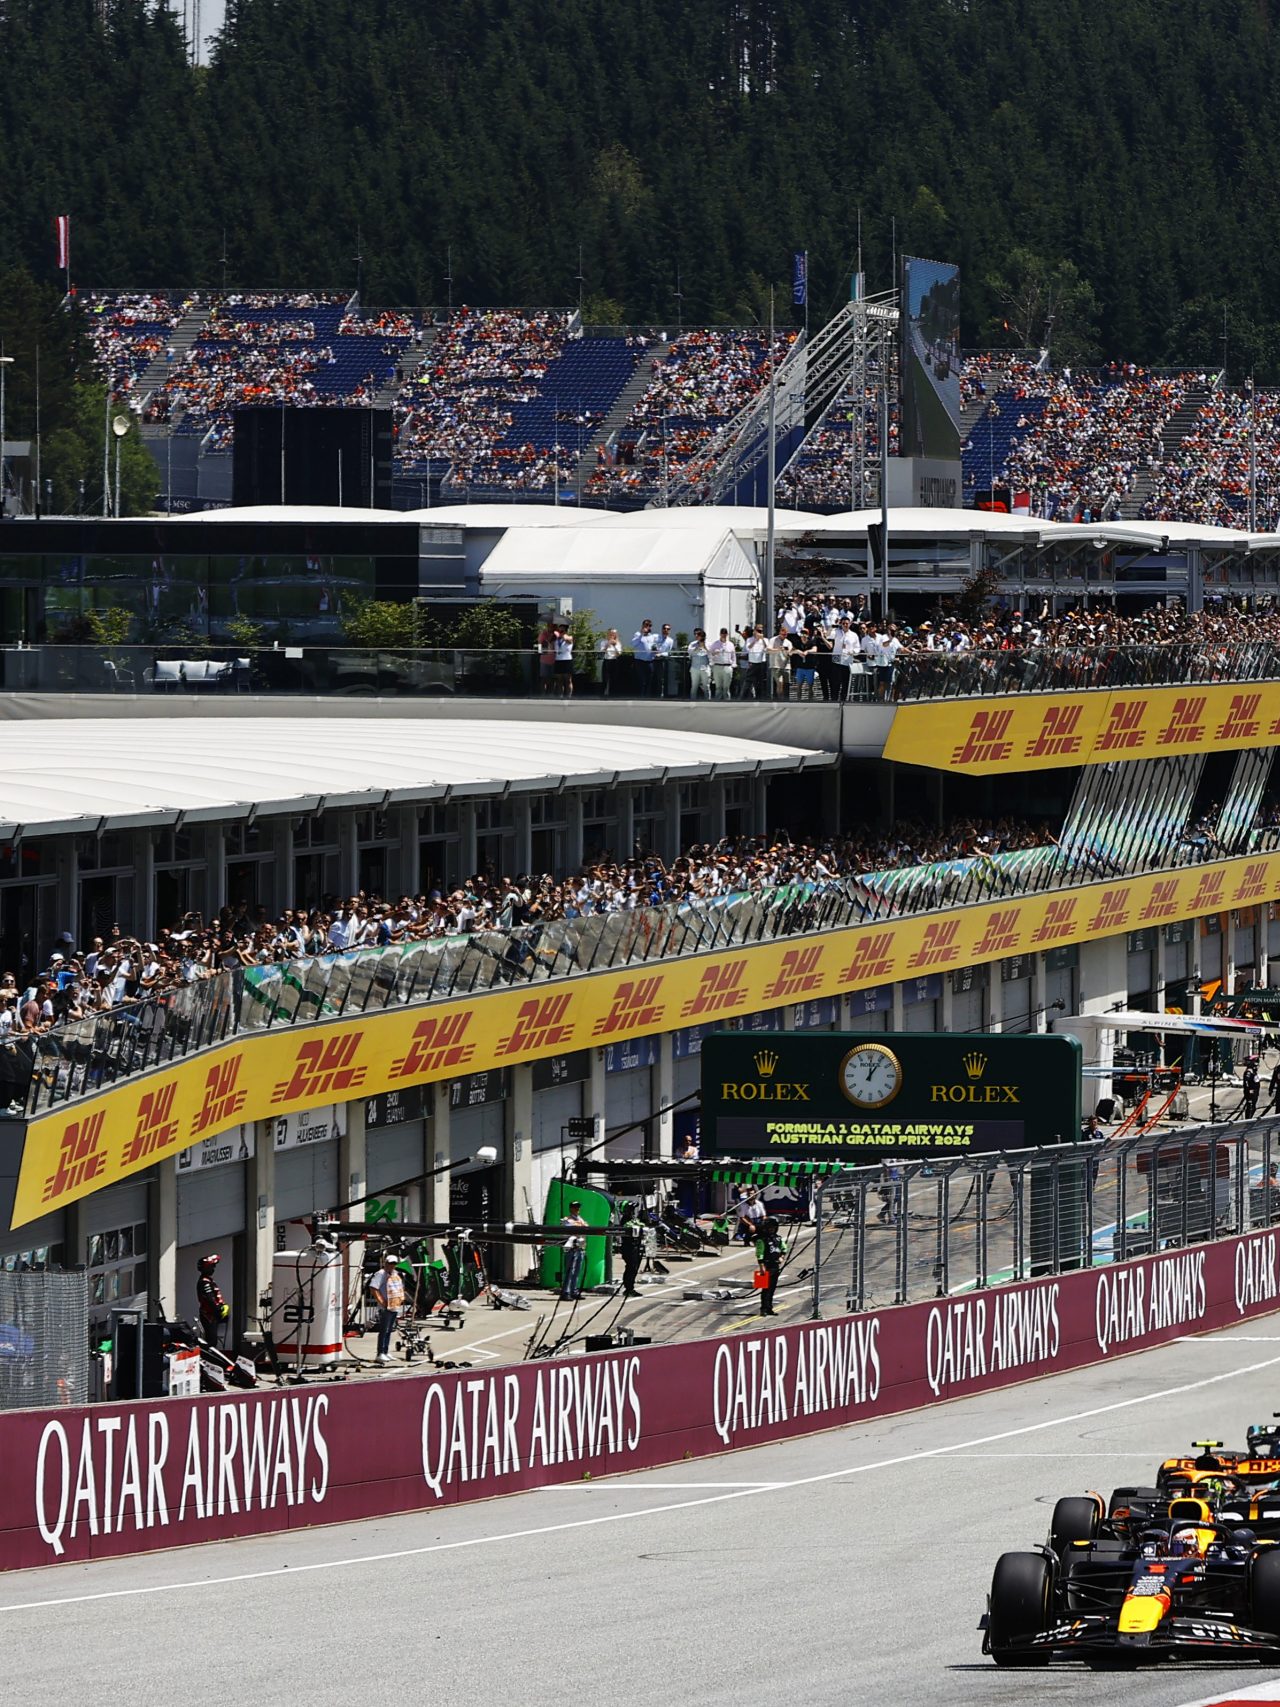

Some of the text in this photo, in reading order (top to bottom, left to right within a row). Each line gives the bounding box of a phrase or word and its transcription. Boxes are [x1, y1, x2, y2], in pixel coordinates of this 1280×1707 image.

[951, 709, 1014, 764] DHL
[1025, 705, 1083, 757] DHL
[1095, 701, 1148, 751] DHL
[1157, 697, 1207, 745] DHL
[1214, 693, 1261, 740] DHL
[42, 1110, 108, 1203] DHL
[120, 1082, 179, 1166] DHL
[190, 1053, 248, 1136] DHL
[271, 1031, 368, 1103] DHL
[388, 1012, 477, 1080] DHL
[493, 993, 576, 1058] DHL
[591, 976, 666, 1037] DHL
[680, 960, 748, 1017] DHL
[763, 945, 824, 999] DHL
[838, 932, 895, 984] DHL
[907, 920, 960, 968] DHL
[971, 908, 1021, 956] DHL
[1031, 898, 1077, 943] DHL
[1087, 888, 1130, 932] DHL
[1138, 880, 1179, 920] DHL
[1186, 870, 1225, 911] DHL
[1233, 862, 1268, 900] DHL
[367, 1100, 377, 1123] 24
[452, 1082, 462, 1105] 77
[469, 1088, 485, 1105] BOTTAS
[721, 1083, 810, 1101] ROLEX
[930, 1085, 1020, 1103] ROLEX
[276, 1119, 288, 1145] 27
[767, 1123, 974, 1136] FORMULA 1 QATAR AIRWAYS
[770, 1134, 970, 1146] AUSTRIAN GRAND PRIX 2024
[1234, 1234, 1277, 1314] QATAR
[1096, 1250, 1206, 1354] QATAR AIRWAYS
[926, 1283, 1060, 1396] QATAR AIRWAYS
[713, 1317, 880, 1445] QATAR AIRWAYS
[421, 1356, 641, 1498] QATAR AIRWAYS
[36, 1393, 329, 1556] QATAR AIRWAYS
